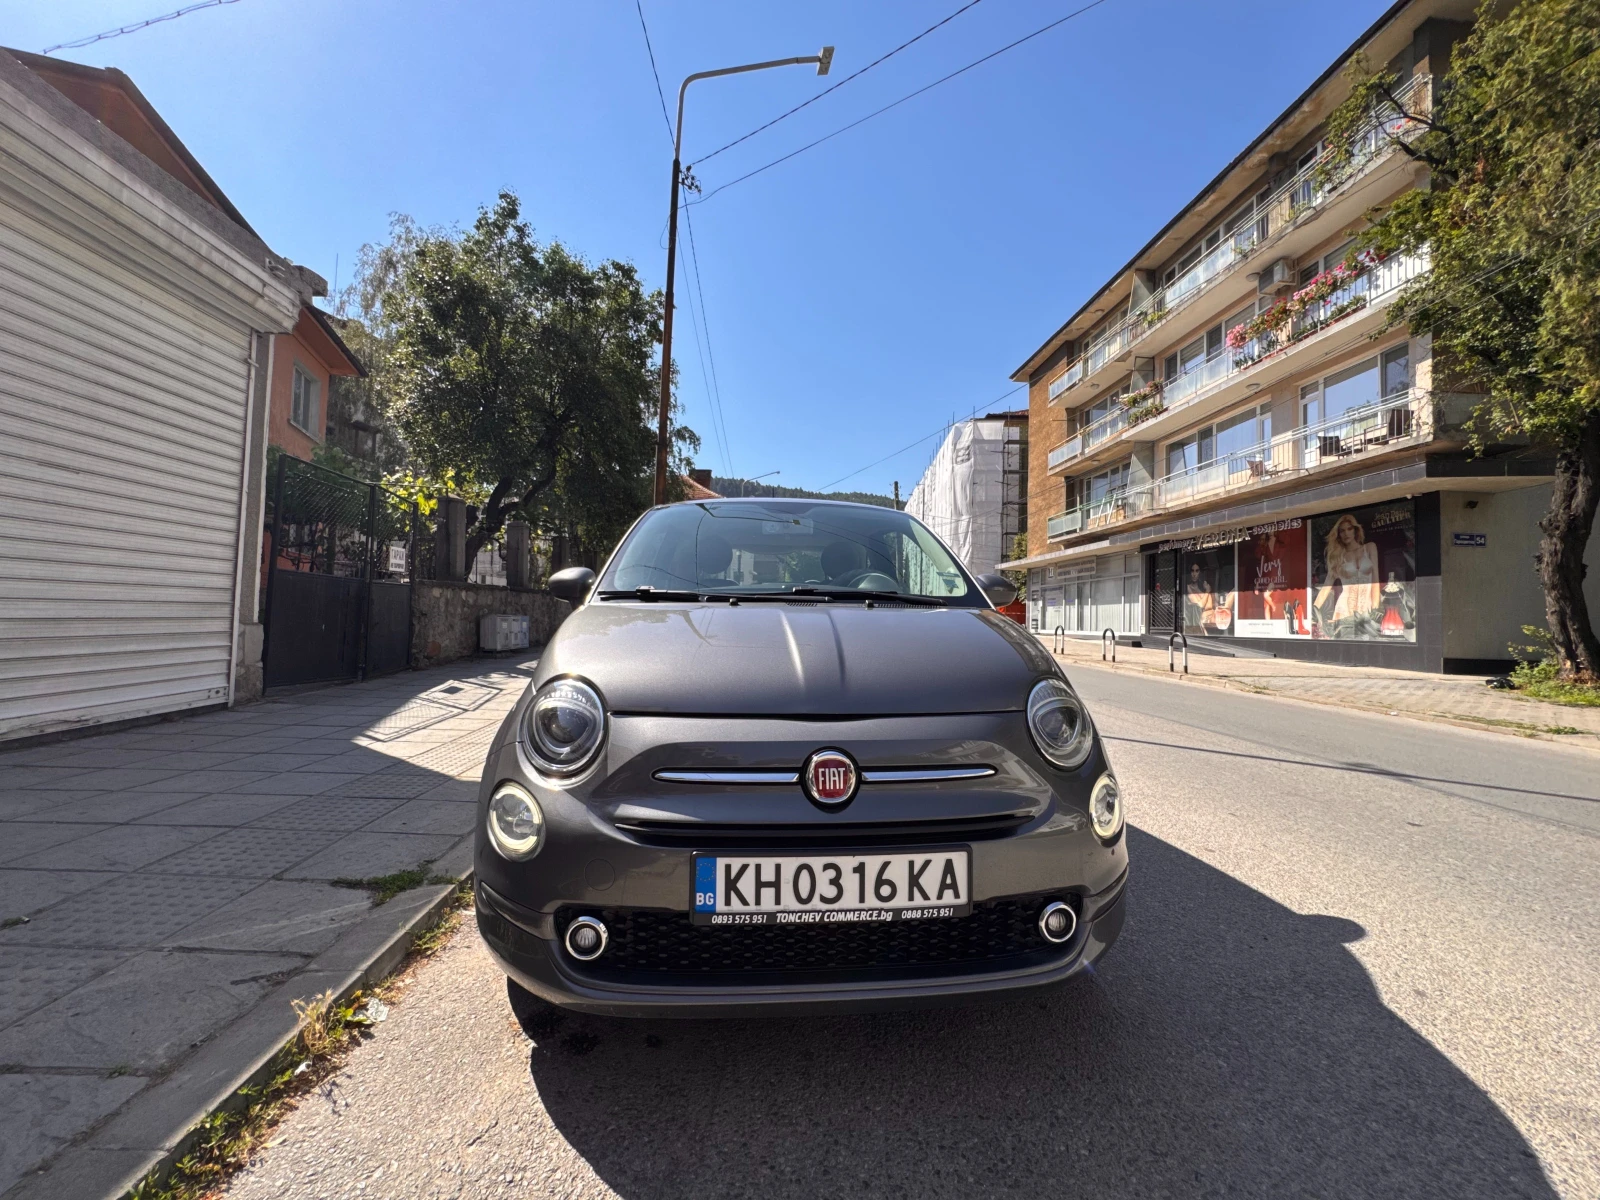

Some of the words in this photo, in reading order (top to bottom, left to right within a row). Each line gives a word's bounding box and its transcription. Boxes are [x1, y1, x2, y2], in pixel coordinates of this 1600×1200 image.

[1256, 555, 1282, 577] Very
[818, 767, 847, 790] FIAT
[696, 892, 714, 905] BG
[711, 914, 733, 924] 0893
[734, 914, 751, 924] 575
[752, 914, 767, 924] 951
[776, 911, 823, 923] TONCHEV
[823, 910, 893, 921] COMMERCE.bg
[901, 909, 921, 919] 0888
[923, 908, 938, 918] 575
[939, 907, 954, 917] 951
